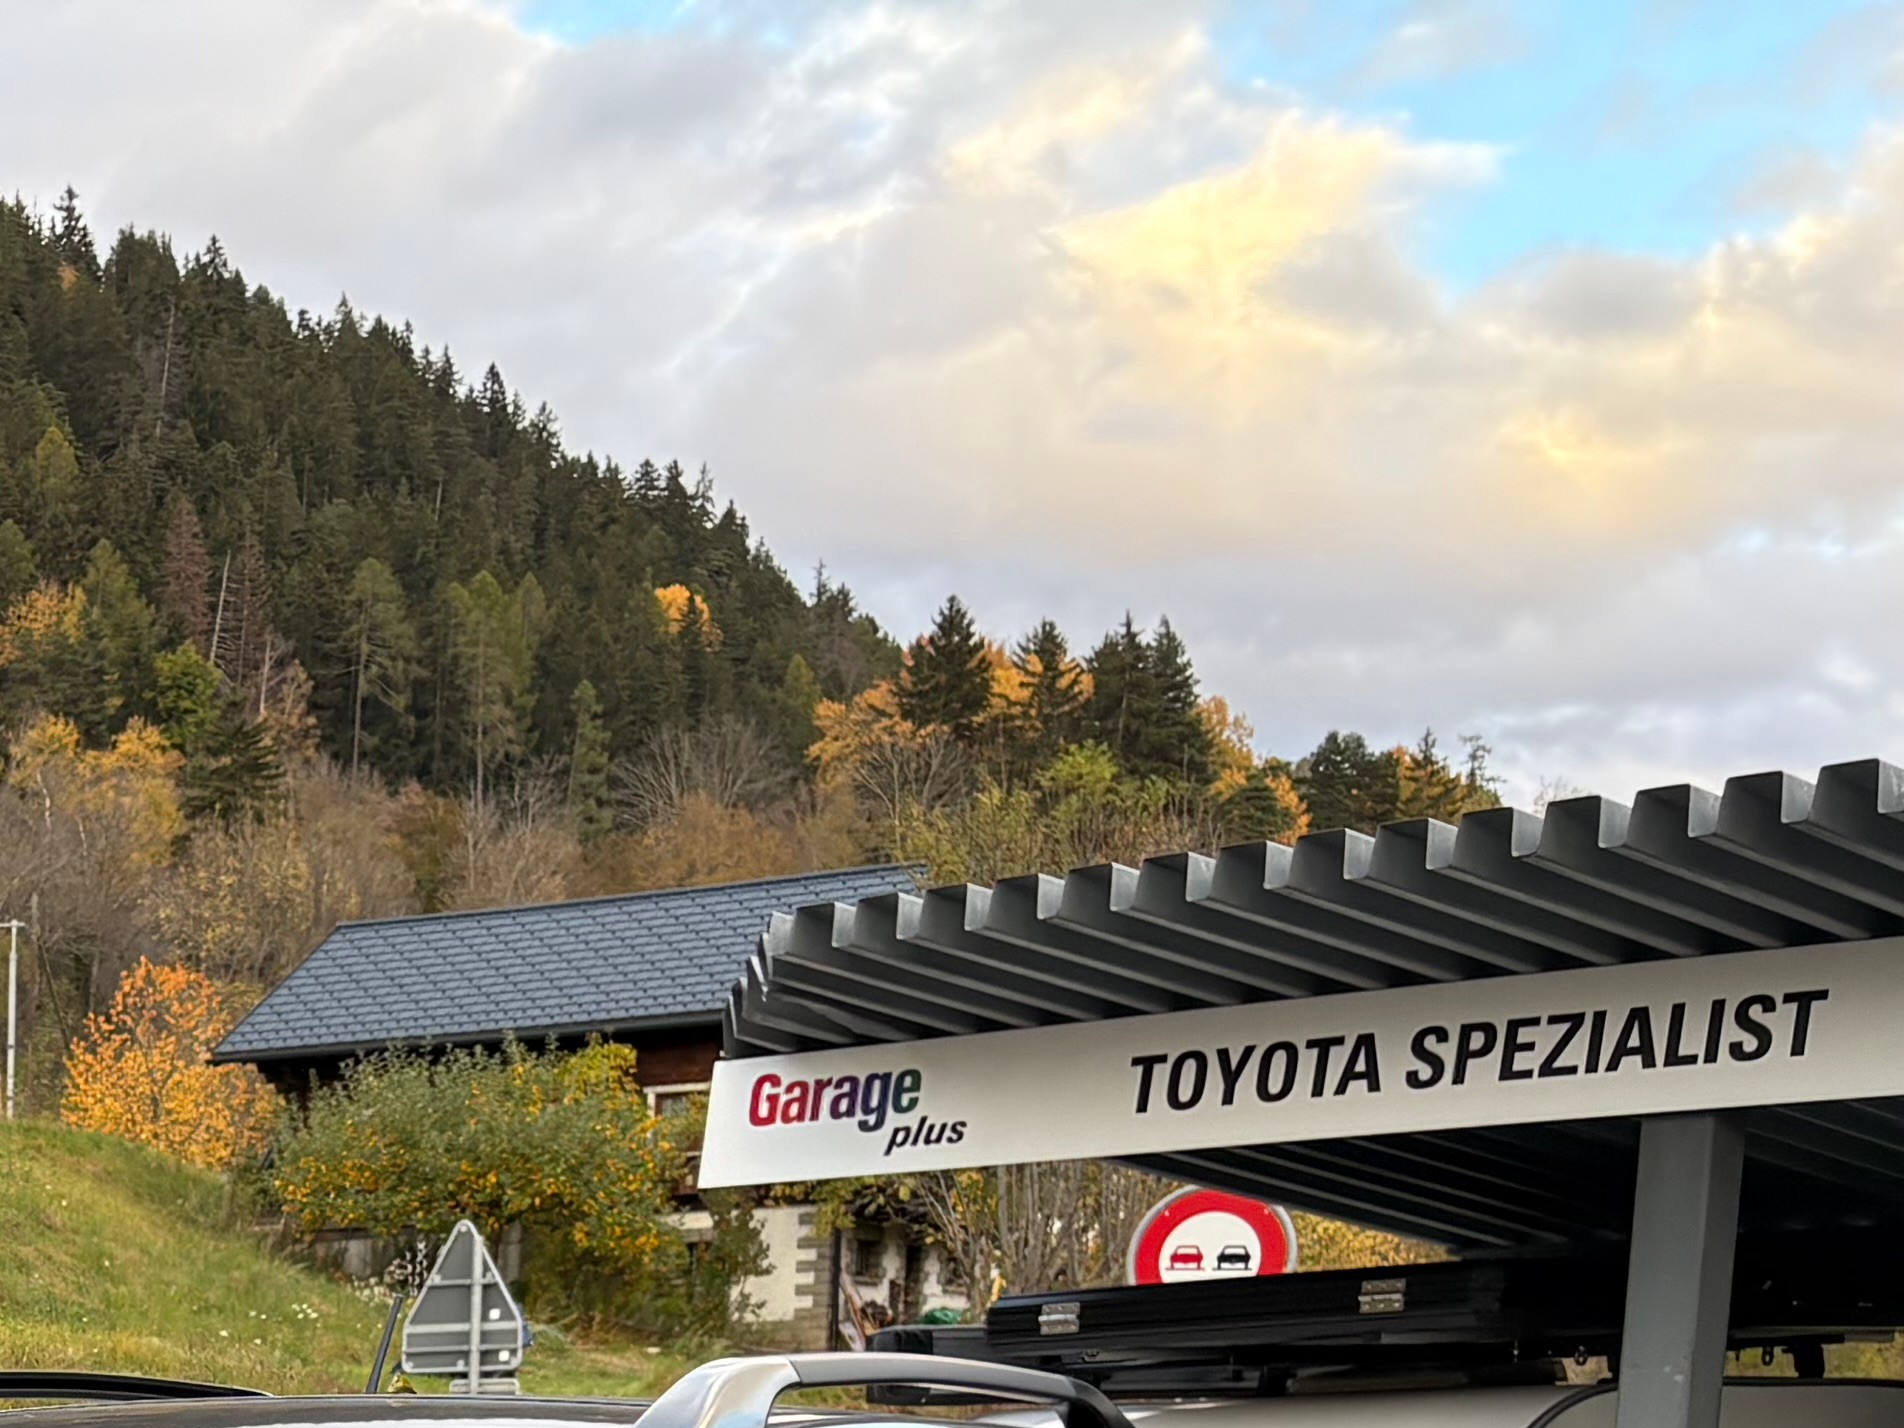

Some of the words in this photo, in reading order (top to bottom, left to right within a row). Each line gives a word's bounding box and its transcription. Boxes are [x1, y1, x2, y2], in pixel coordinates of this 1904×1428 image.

[1131, 1032, 1383, 1115] TOYOTA
[1405, 989, 1830, 1090] SPEZIALIST
[749, 1068, 923, 1132] Garage
[883, 1115, 969, 1157] plus
